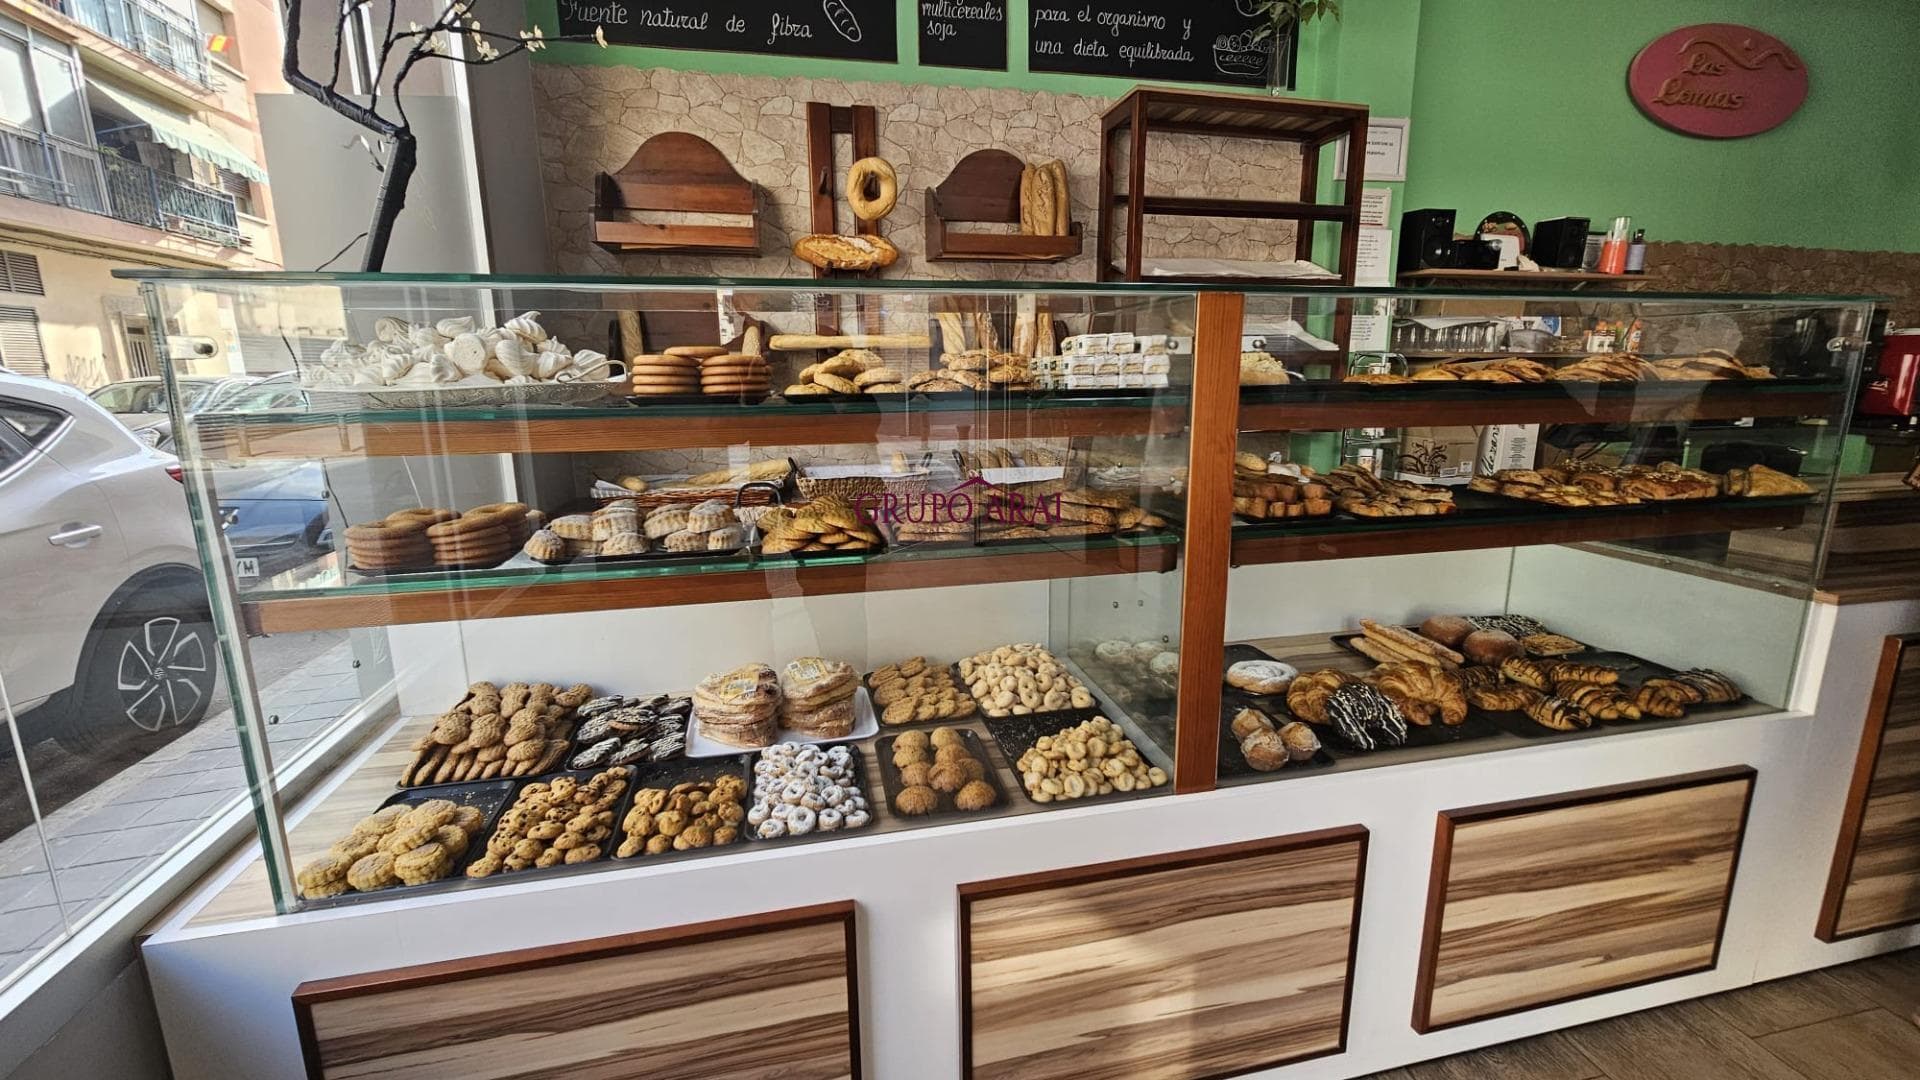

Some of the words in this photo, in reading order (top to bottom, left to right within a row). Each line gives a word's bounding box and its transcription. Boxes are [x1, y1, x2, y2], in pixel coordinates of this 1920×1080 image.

[640, 8, 709, 30] natural
[725, 14, 746, 33] de
[767, 13, 813, 45] fibra
[922, 2, 1003, 22] multicereales
[1034, 9, 1070, 28] para
[1077, 5, 1092, 22] el
[1097, 10, 1166, 37] organismo
[1183, 18, 1192, 40] y
[927, 20, 957, 41] soja
[1035, 40, 1064, 55] una
[1073, 38, 1109, 58] dieta
[1119, 43, 1195, 68] equilibrada
[1682, 53, 1726, 76] Las
[1652, 78, 1744, 110] Lomas
